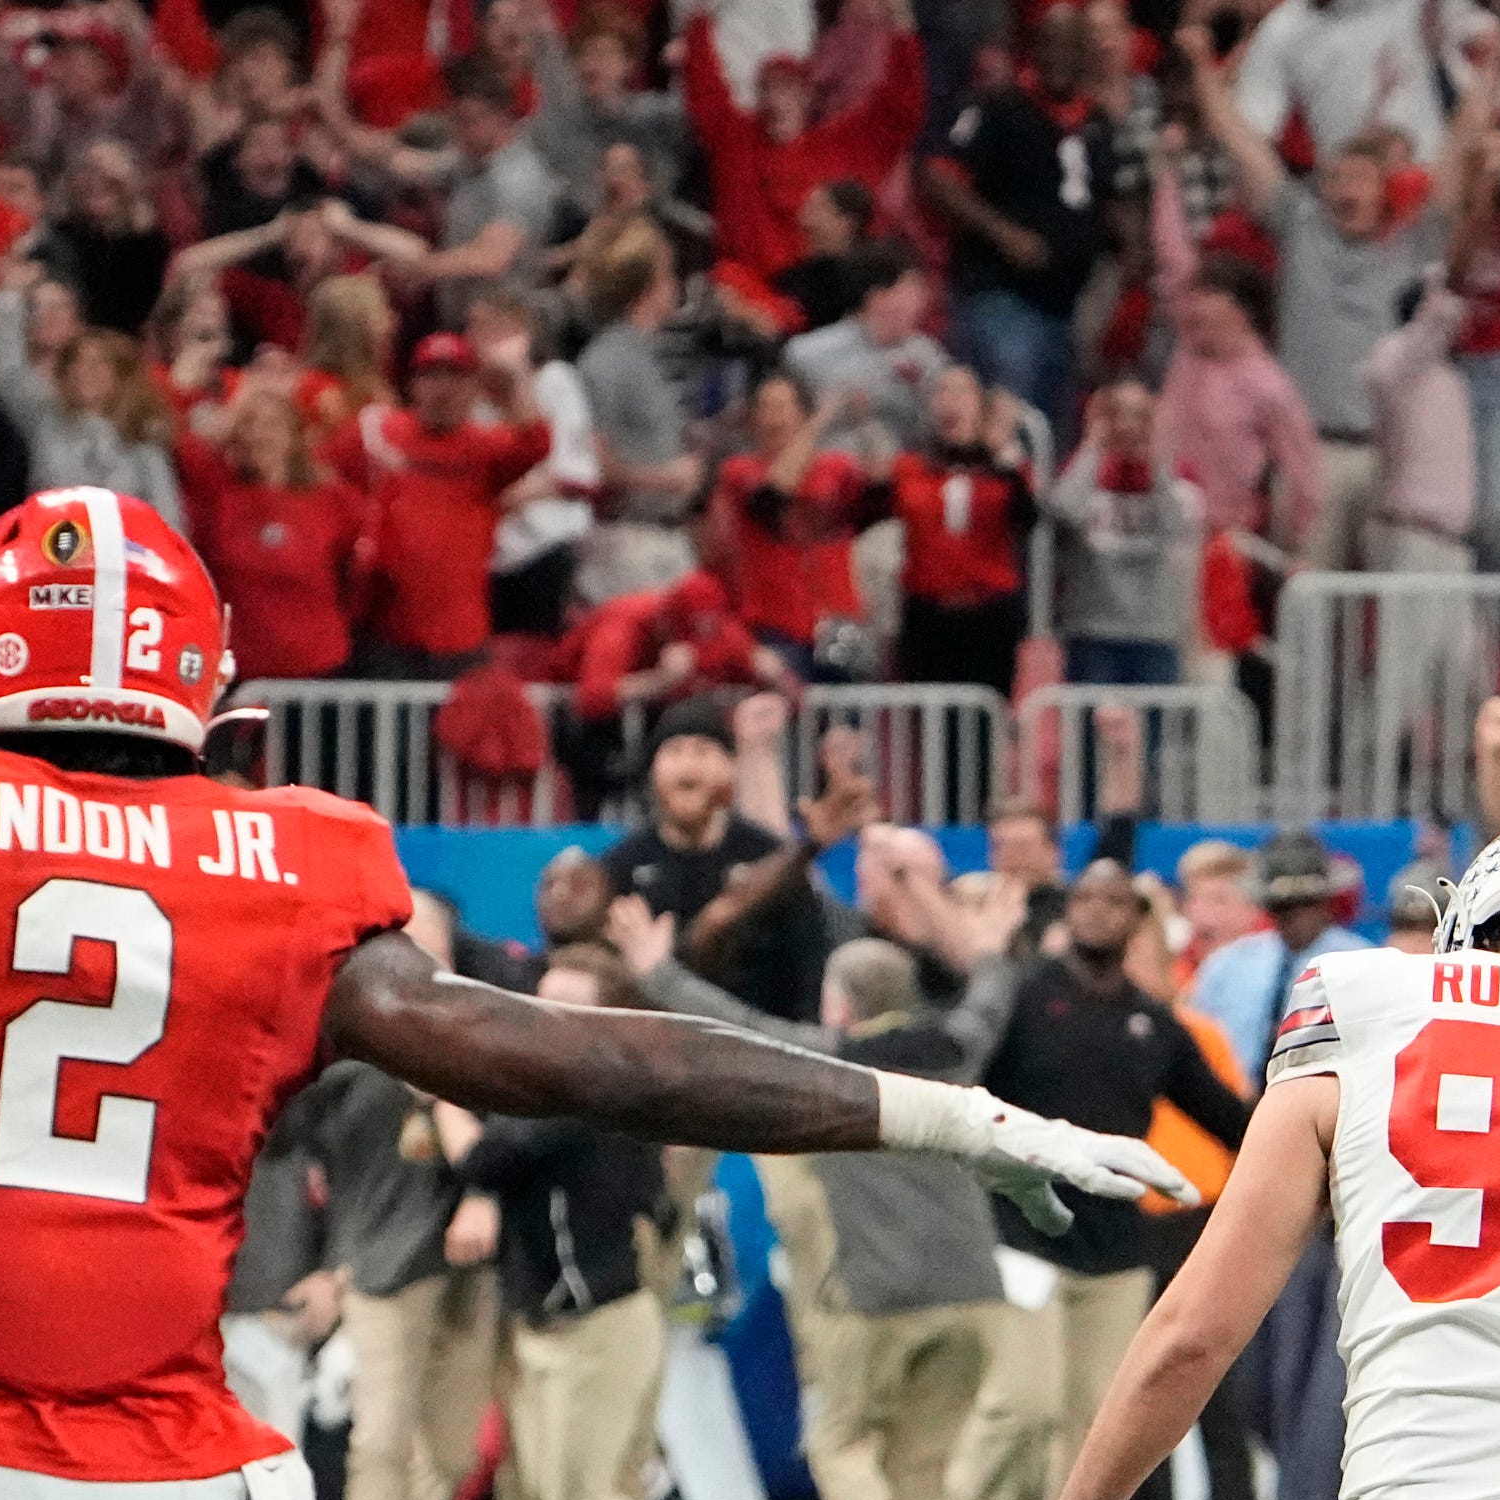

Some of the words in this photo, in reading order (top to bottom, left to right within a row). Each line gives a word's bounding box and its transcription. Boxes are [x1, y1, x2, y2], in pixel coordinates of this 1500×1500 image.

[126, 607, 164, 672] 2
[28, 698, 167, 730] GEORGIA
[198, 810, 299, 885] JR.
